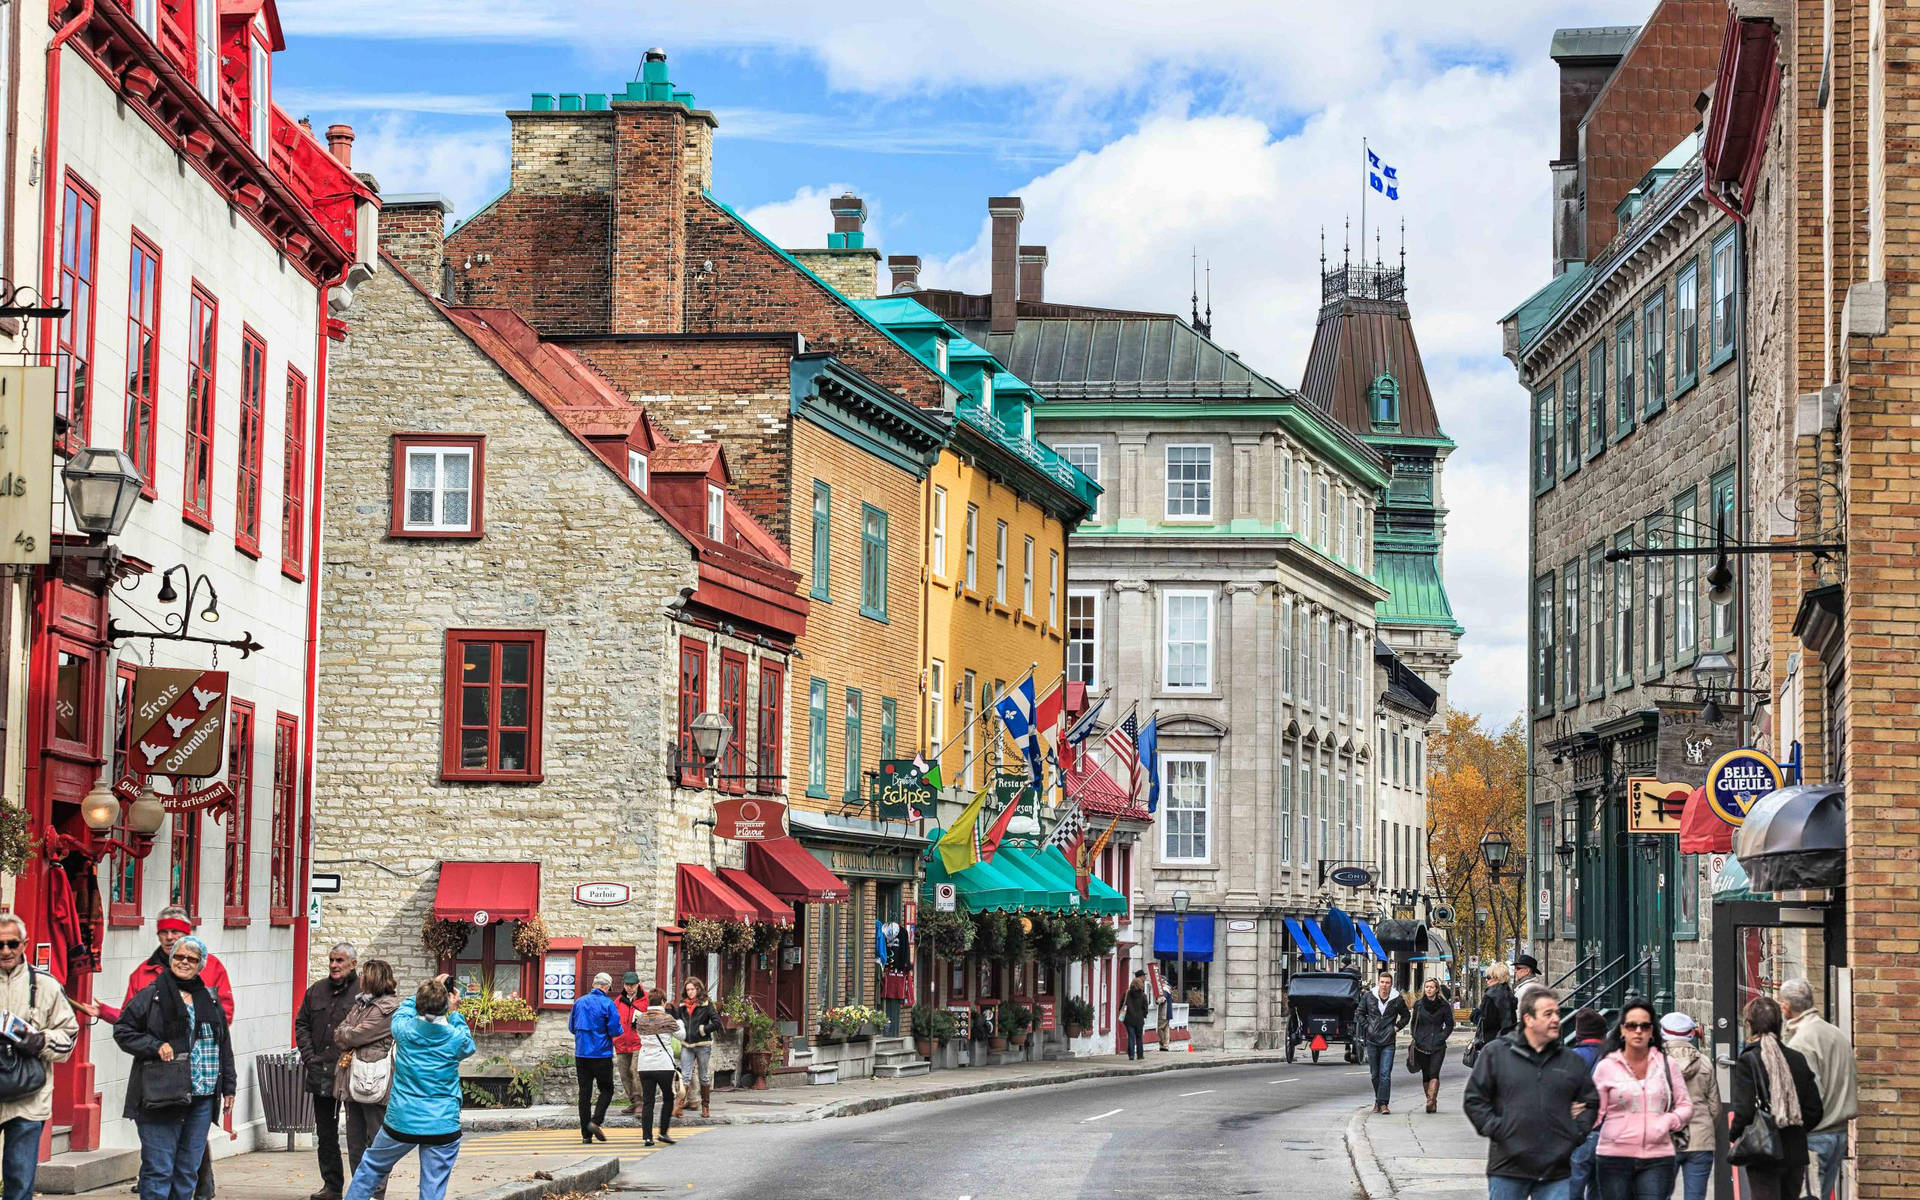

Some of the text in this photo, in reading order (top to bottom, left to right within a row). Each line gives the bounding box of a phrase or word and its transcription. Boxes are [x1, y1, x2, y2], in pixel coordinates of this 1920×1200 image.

[140, 684, 179, 720] Trois
[166, 717, 220, 772] Colombes
[1724, 766, 1765, 779] BELLE
[1717, 778, 1773, 791] GUEULE
[883, 781, 931, 811] Eclipse
[1633, 782, 1641, 828] SUSHI
[589, 890, 617, 898] Parloir
[1321, 1023, 1328, 1032] 6
